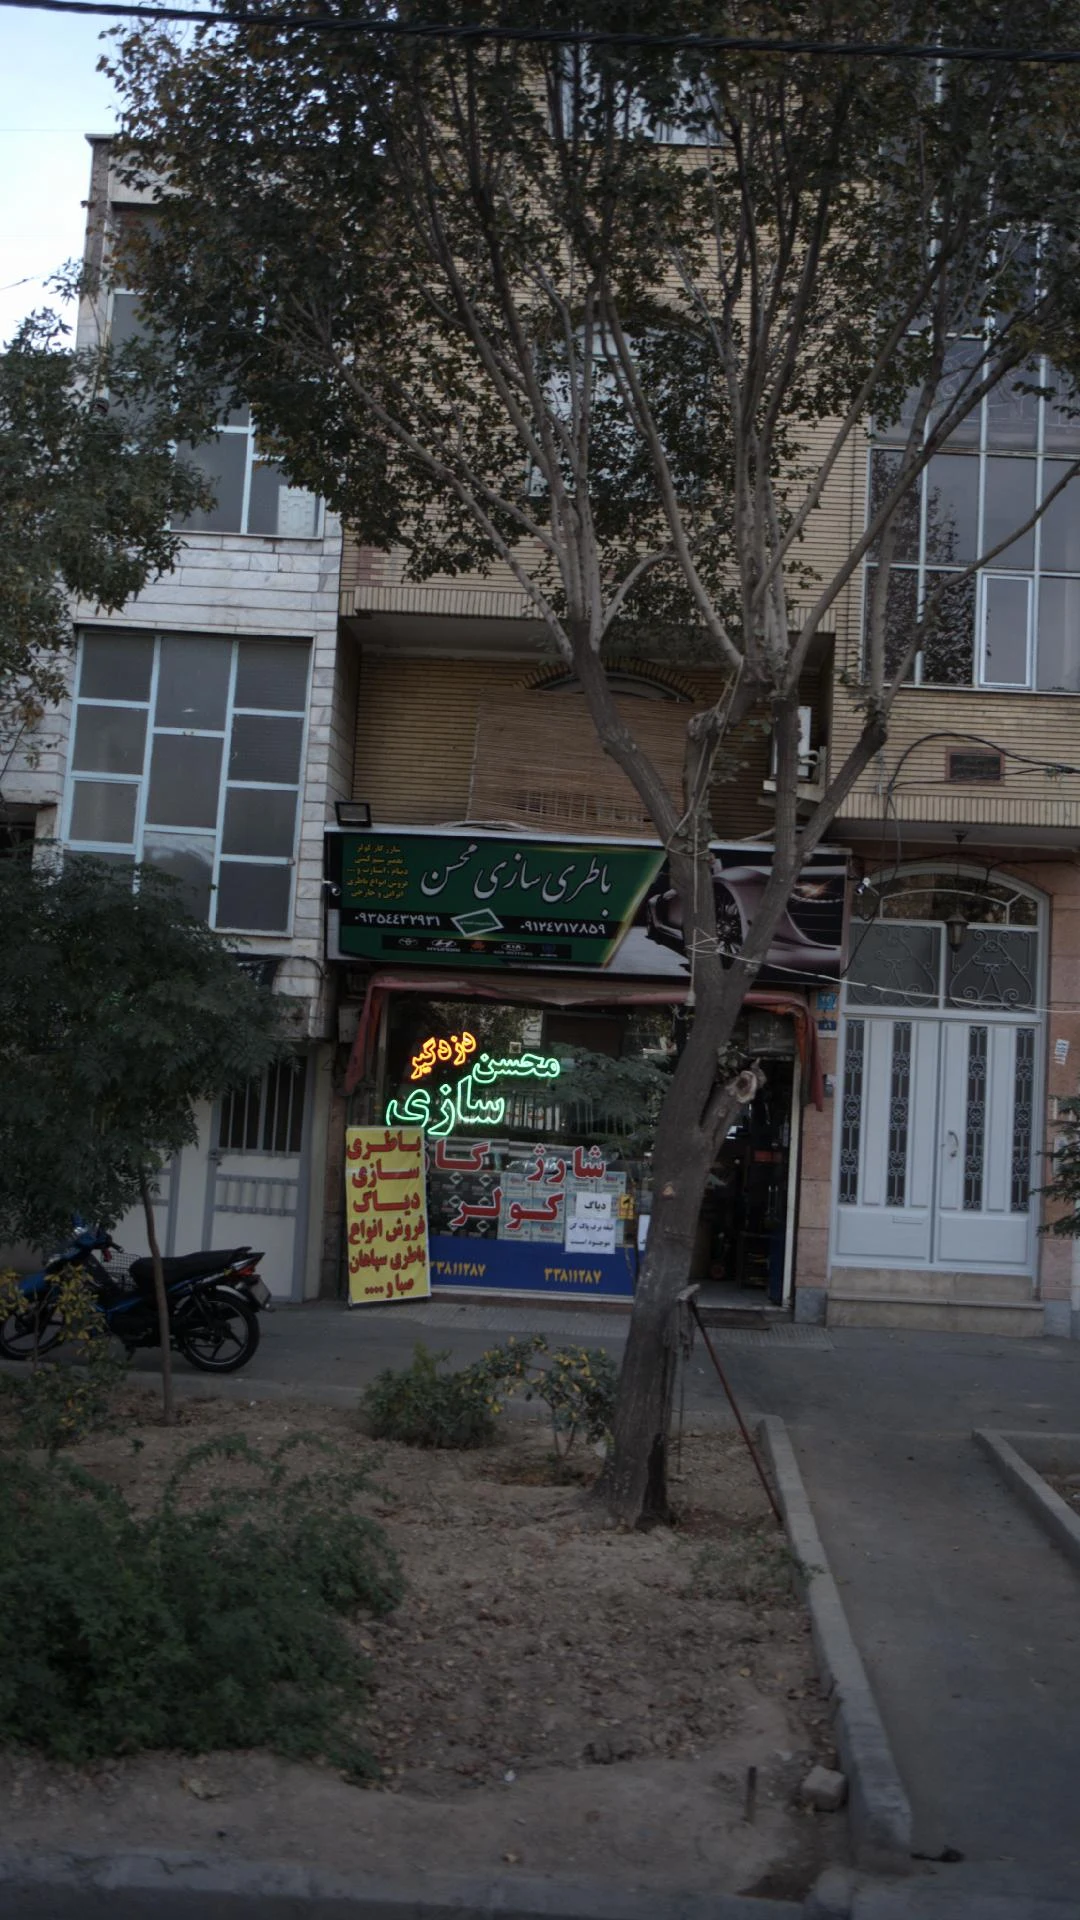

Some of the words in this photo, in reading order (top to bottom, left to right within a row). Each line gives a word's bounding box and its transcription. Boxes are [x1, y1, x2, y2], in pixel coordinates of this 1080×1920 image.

[420, 843, 479, 897] محسن
[474, 852, 542, 900] سازی
[542, 856, 611, 917] باطری
[472, 1052, 562, 1084] محسن
[386, 1074, 505, 1136] سازی
[347, 1130, 421, 1160] باطری
[425, 1139, 491, 1177] گا
[352, 1158, 420, 1188] سازی
[526, 1143, 607, 1184] شارژ
[450, 1186, 565, 1230] کولر
[349, 1217, 383, 1245] انواع
[386, 1215, 426, 1242] فروش
[349, 1248, 387, 1273] سپاهان
[390, 1245, 426, 1271] باطری
[386, 1281, 393, 1298] و
[395, 1272, 414, 1296] صبا
